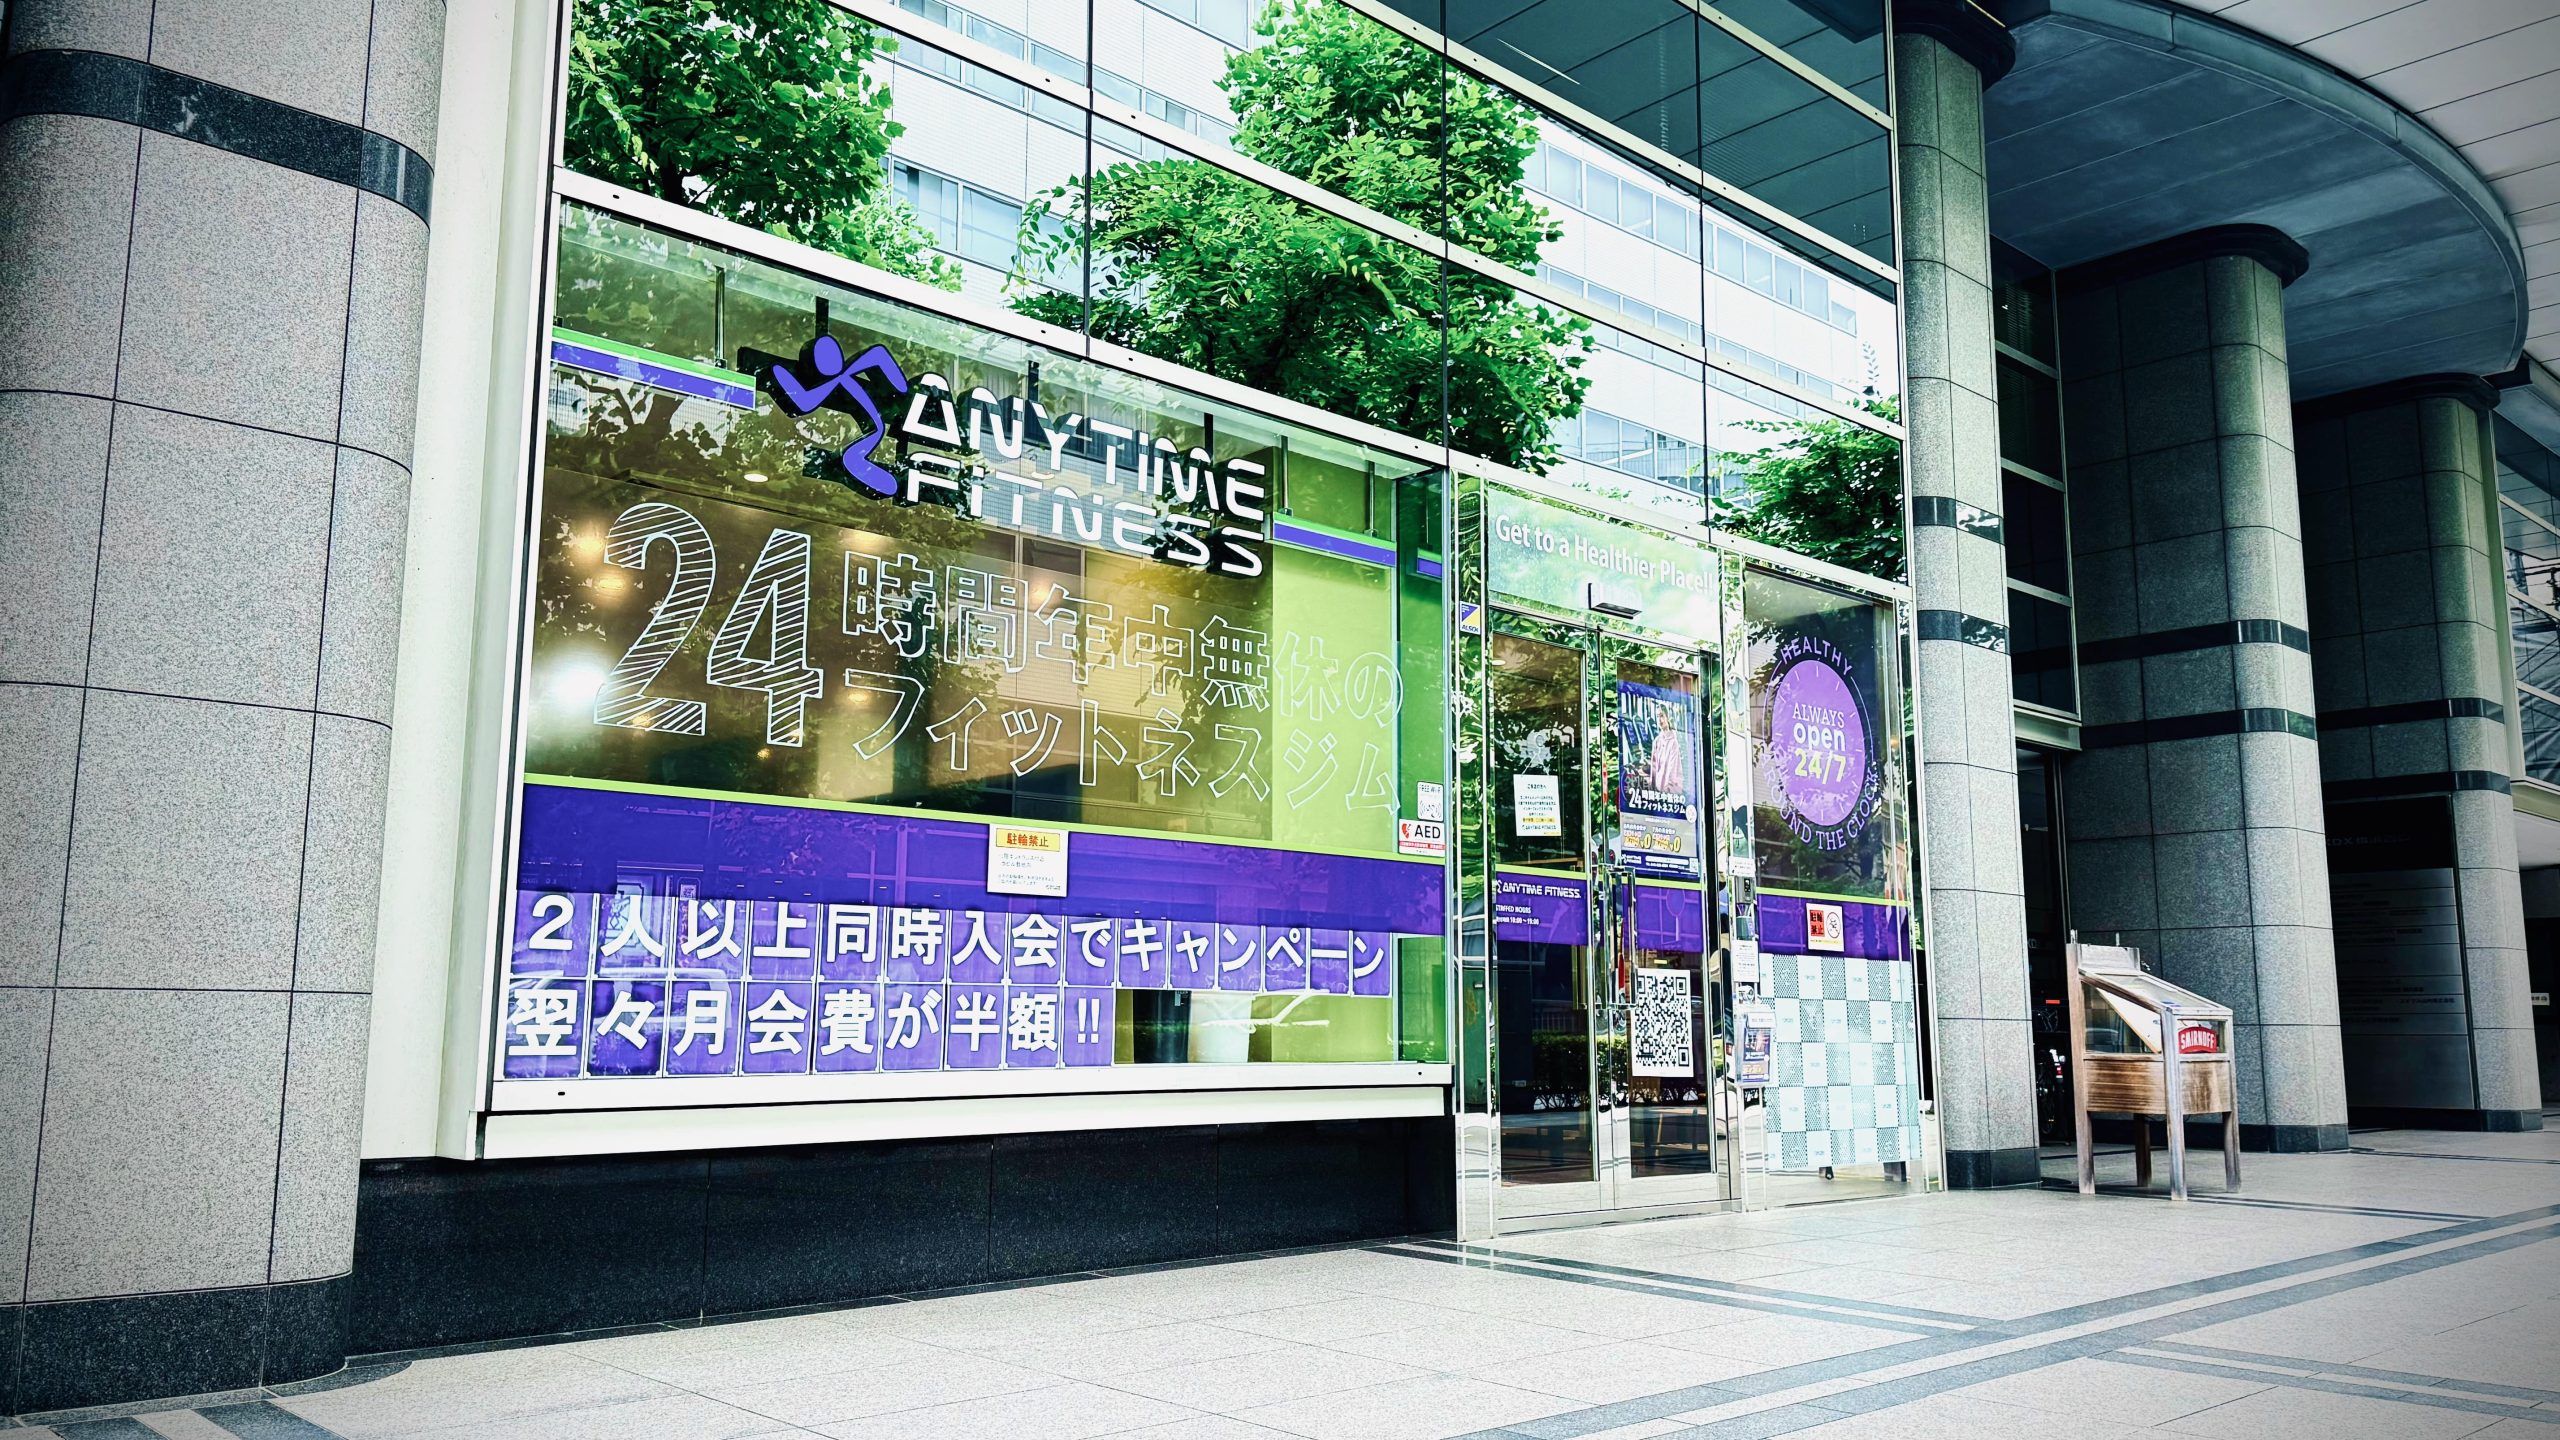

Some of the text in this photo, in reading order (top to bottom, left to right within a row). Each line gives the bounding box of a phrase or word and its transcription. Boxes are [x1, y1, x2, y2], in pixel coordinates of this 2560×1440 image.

[902, 373, 1265, 522] ANYTIME
[906, 452, 1265, 578] FITNESS
[1495, 514, 1714, 596] Get to a Healthier Place!!
[593, 502, 823, 748] 24
[842, 550, 1404, 728] 時間年中無休の
[1780, 636, 1853, 677] HEALTHY
[1792, 703, 1845, 727] ALWAYS
[844, 668, 1401, 816] フィットネスジム
[1792, 721, 1846, 752] open
[1794, 749, 1847, 785] 24/7
[1629, 787, 1642, 809] 24
[1815, 827, 1847, 851] THE
[1846, 768, 1879, 839] CLOCK
[1006, 832, 1049, 848] 駐輪禁止
[1414, 824, 1441, 839] AED
[1502, 882, 1543, 896] ANYTIME
[528, 893, 1385, 979] 2人以上同時入会でキャンペーン
[2180, 1029, 2215, 1051] SMIRNOFF
